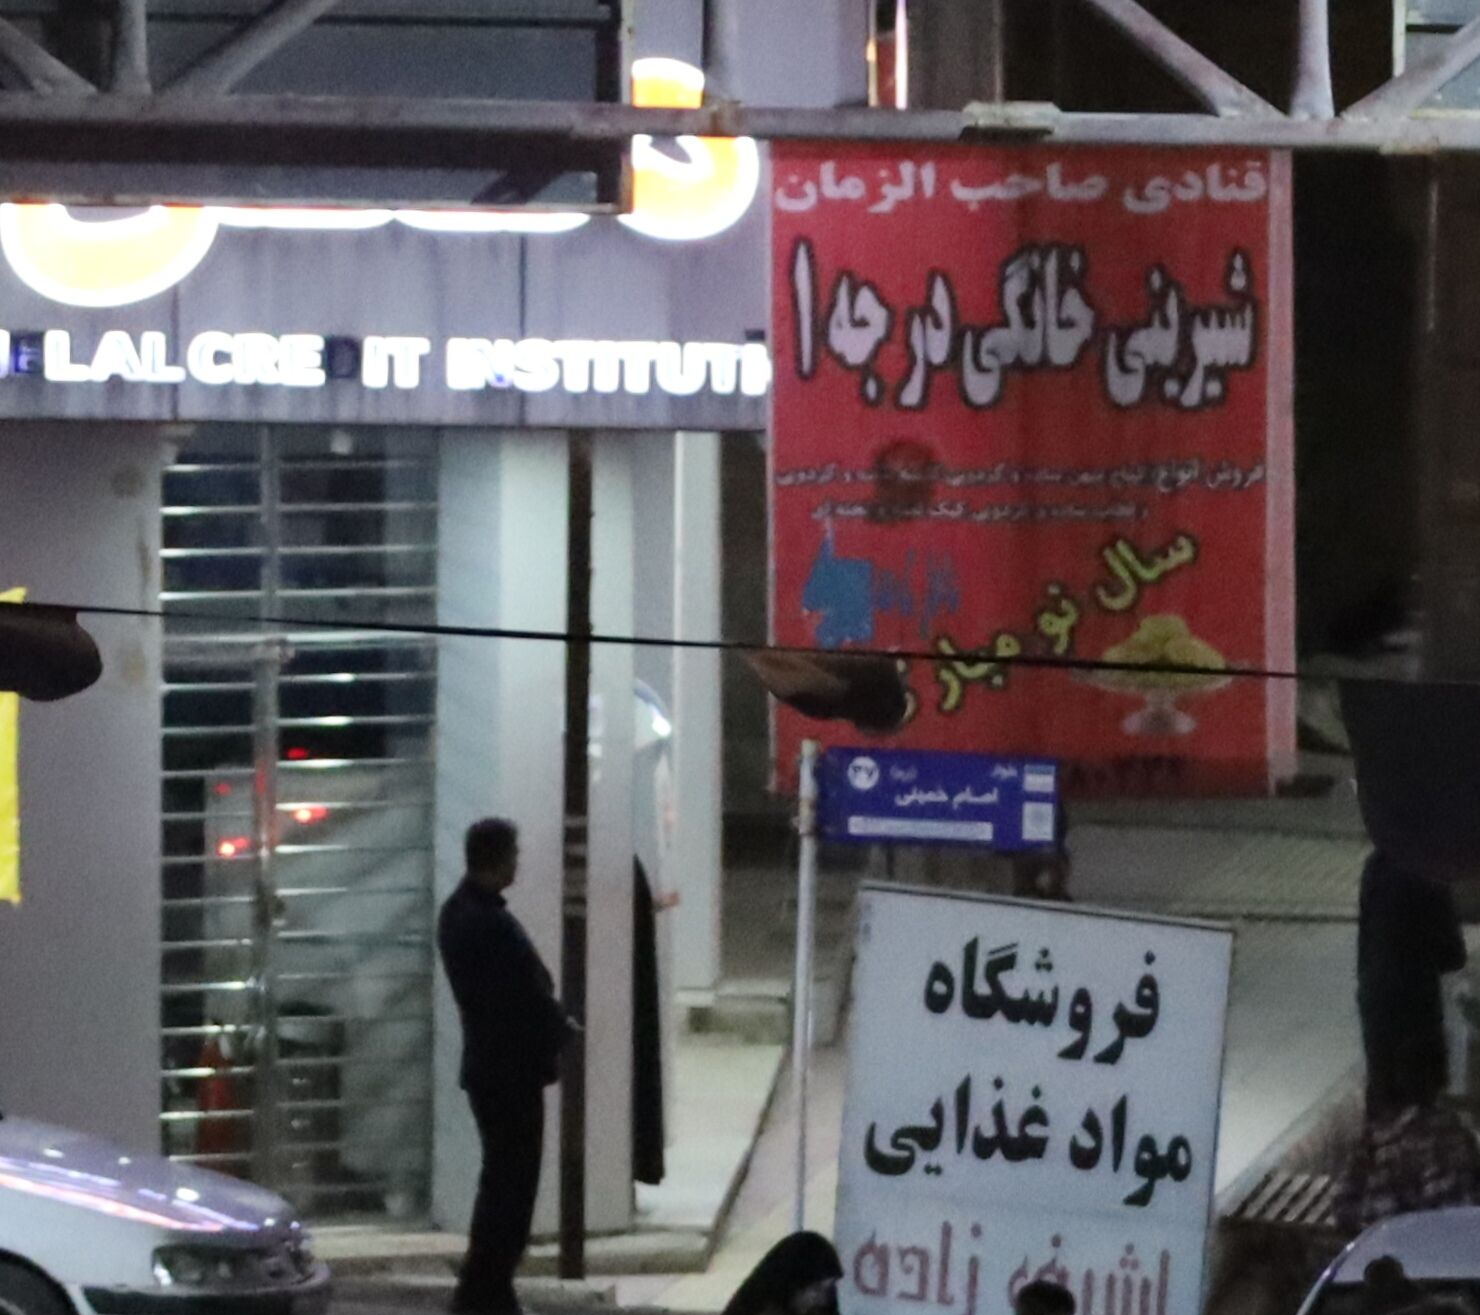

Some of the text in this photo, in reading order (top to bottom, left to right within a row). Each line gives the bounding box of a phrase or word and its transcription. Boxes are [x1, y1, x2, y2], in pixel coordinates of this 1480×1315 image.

[950, 160, 1108, 213] صاحب
[1122, 159, 1267, 215] قنادی
[0, 328, 186, 383] ELAL
[446, 336, 773, 396] INSTITUTI
[960, 240, 1098, 408] خانگی
[1104, 245, 1257, 408] شیرینی
[1098, 534, 1195, 610] سال
[1037, 581, 1079, 653] نو
[924, 936, 1160, 1064] فروشگاه
[863, 1074, 1193, 1206] مواد غذایی
